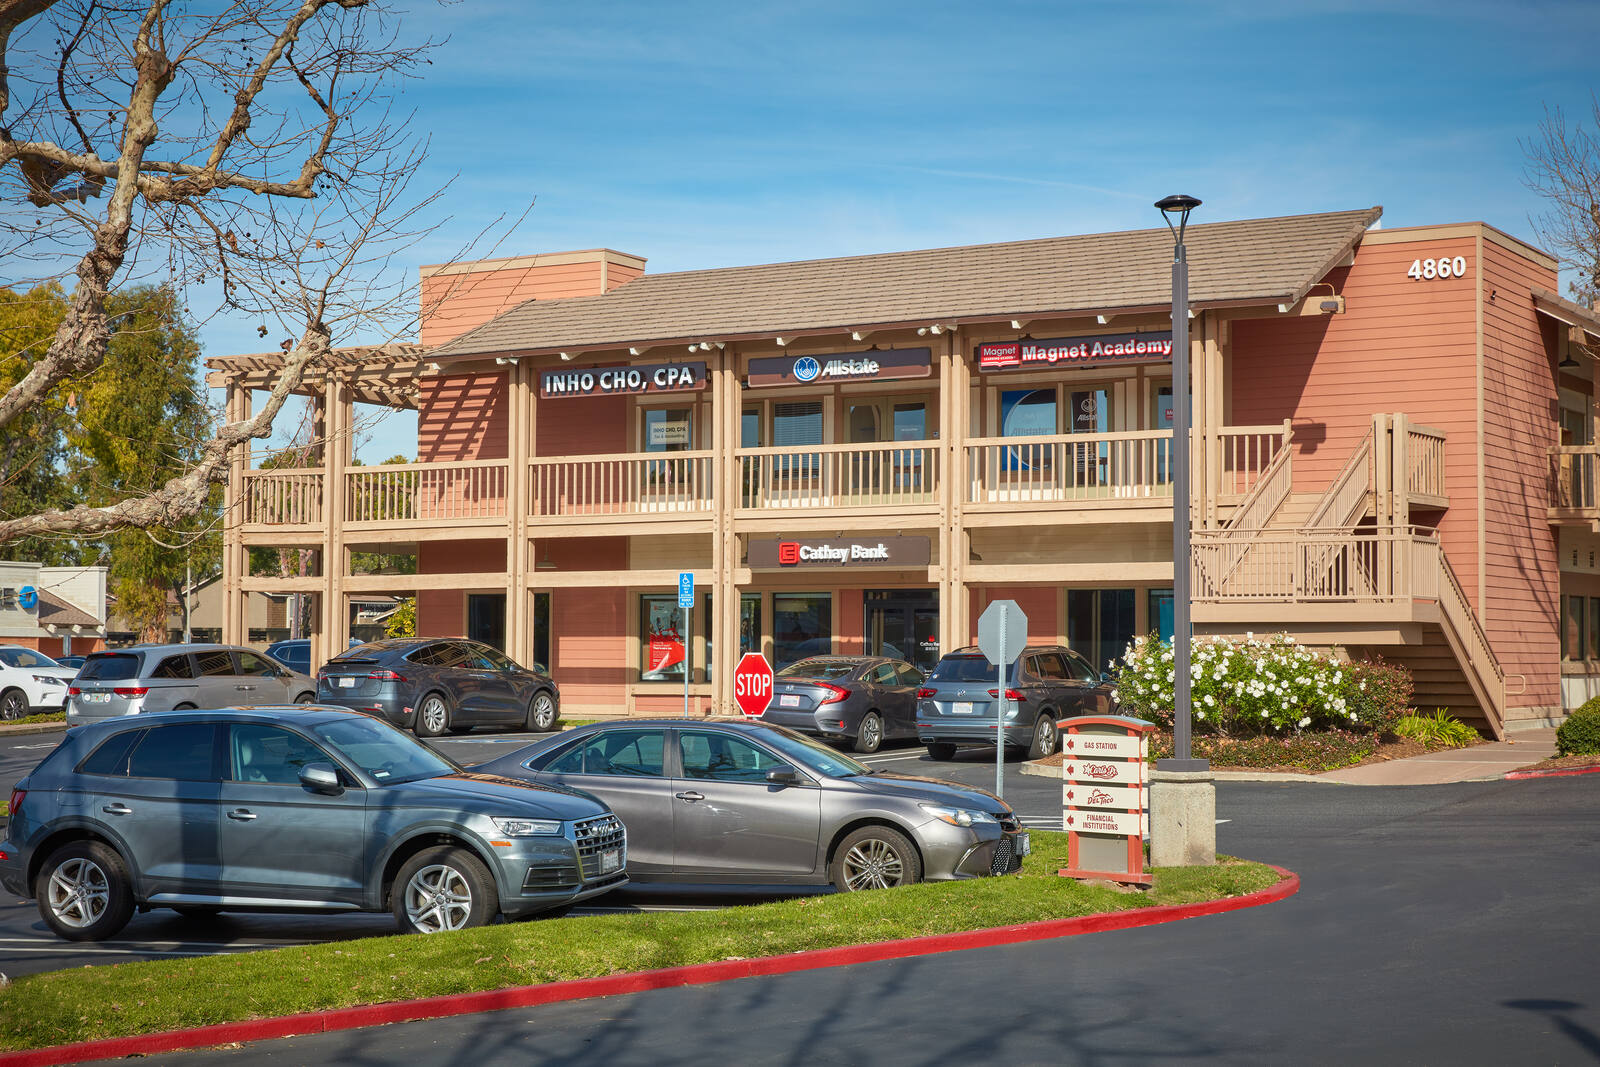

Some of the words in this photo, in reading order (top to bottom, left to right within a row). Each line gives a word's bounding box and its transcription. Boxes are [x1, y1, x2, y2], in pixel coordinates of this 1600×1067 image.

[1407, 255, 1467, 280] 4860
[983, 346, 1016, 357] Magnet
[1022, 343, 1087, 363] Magnet
[1091, 339, 1173, 356] Academy
[821, 358, 880, 376] Allstate
[545, 373, 594, 393] INHO
[599, 370, 647, 390] CHO,
[653, 366, 694, 387] CPA
[799, 544, 849, 563] Cathay
[850, 543, 889, 559] Bank
[736, 673, 771, 697] STOP
[1095, 742, 1118, 750] STATION
[1082, 822, 1119, 831] INSTITUTIONS
[1086, 814, 1115, 822] FINANCIAL
